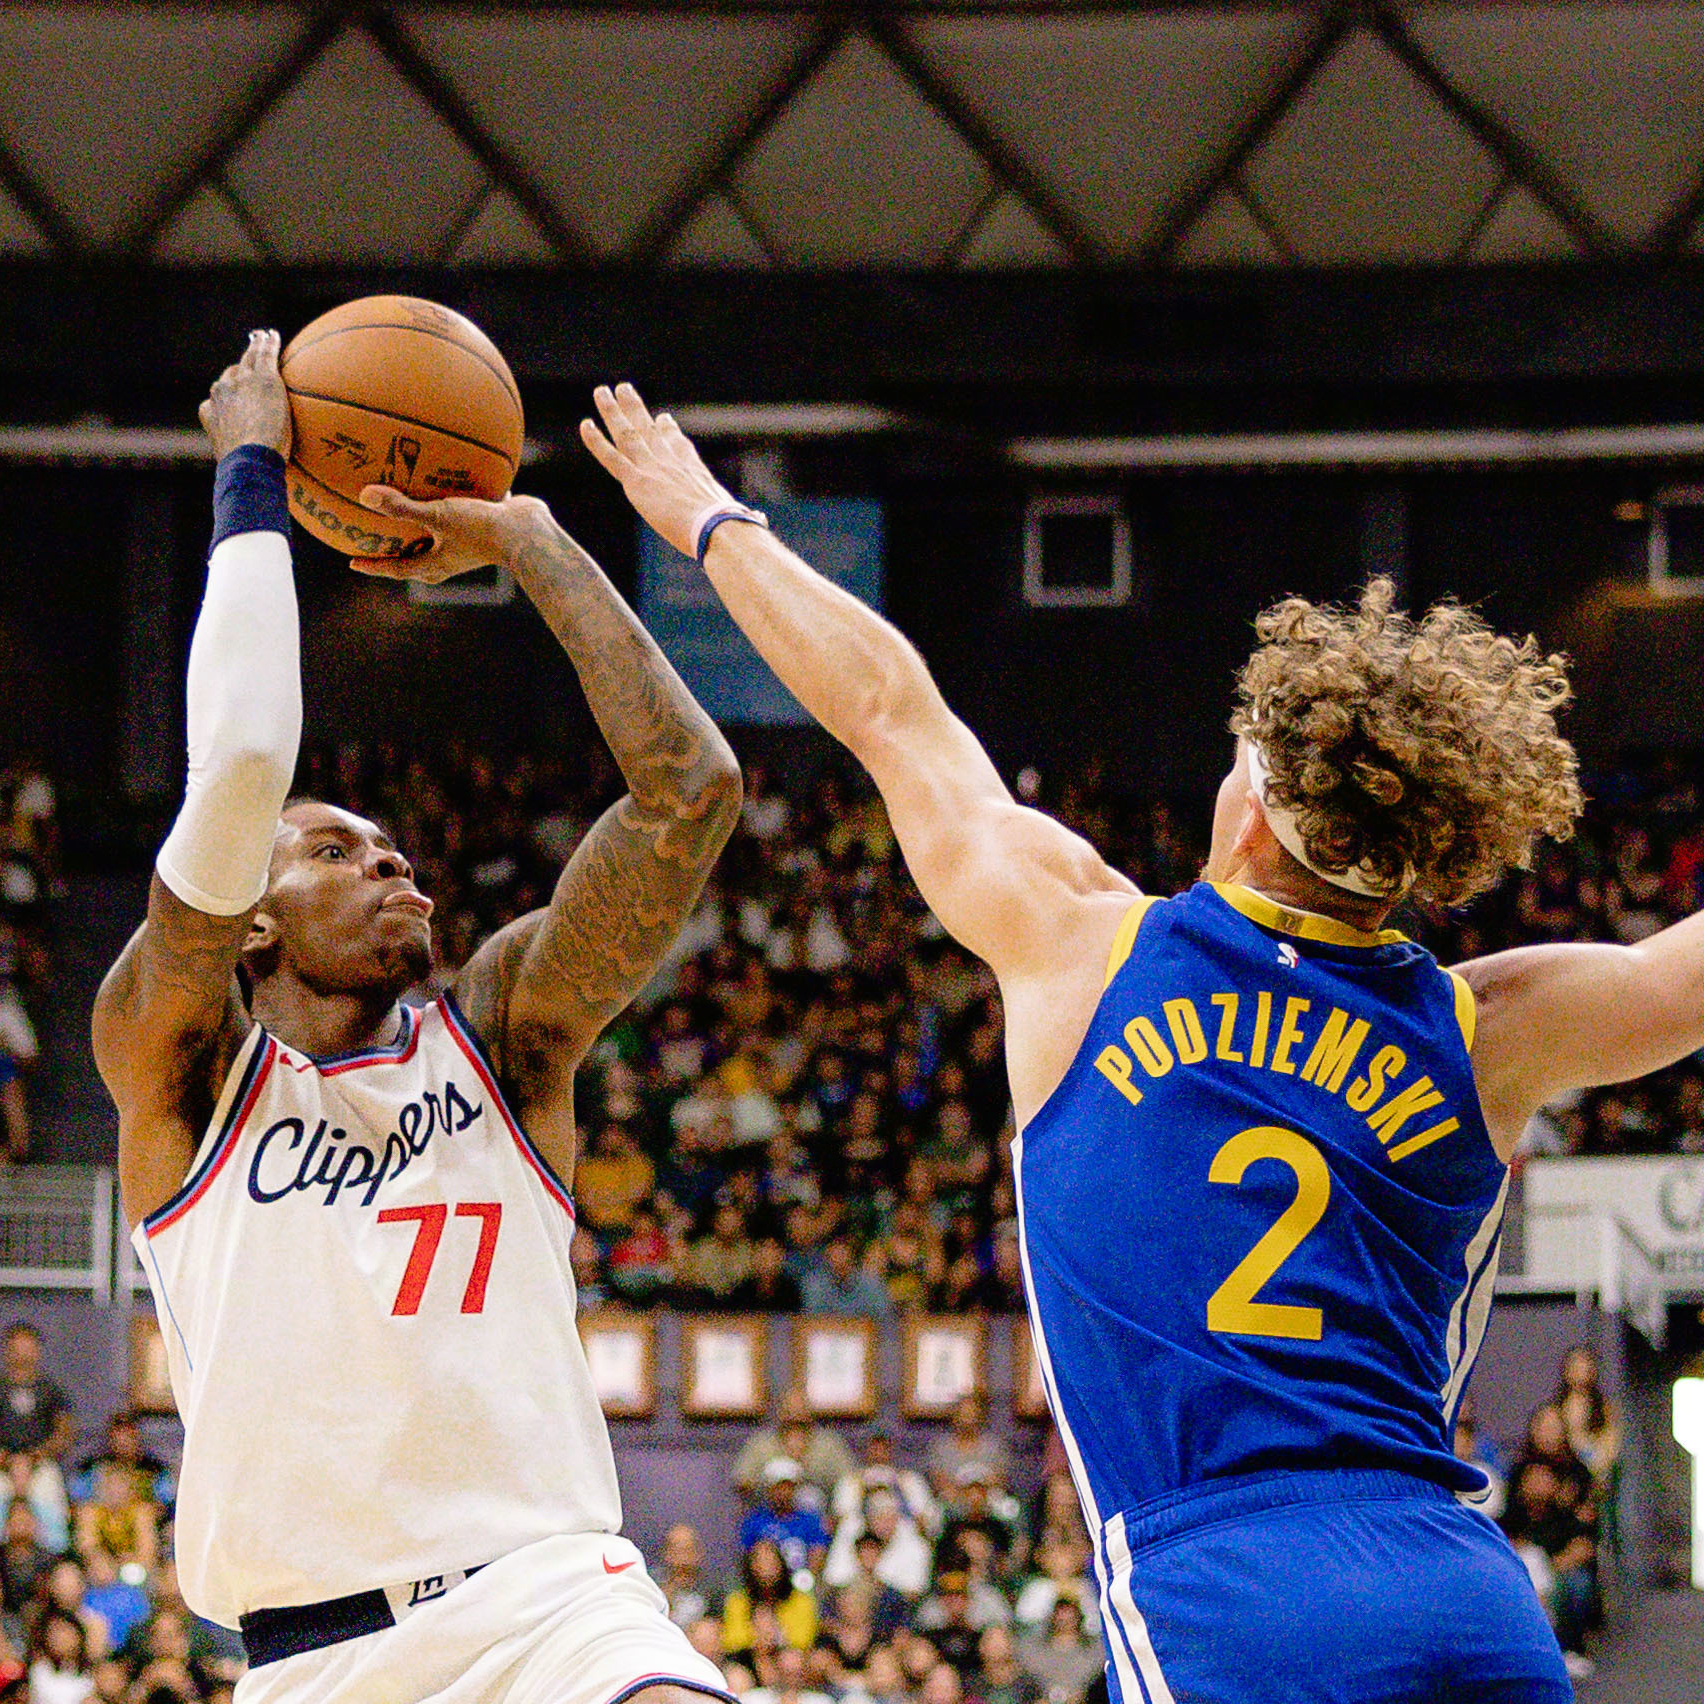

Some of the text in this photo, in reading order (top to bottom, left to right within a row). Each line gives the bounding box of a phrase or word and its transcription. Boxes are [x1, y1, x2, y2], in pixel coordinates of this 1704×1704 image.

[248, 1082, 482, 1207] Clippers
[1093, 991, 1460, 1163] PODZIEMSKI
[377, 1203, 502, 1316] 77
[1206, 1126, 1331, 1341] 2
